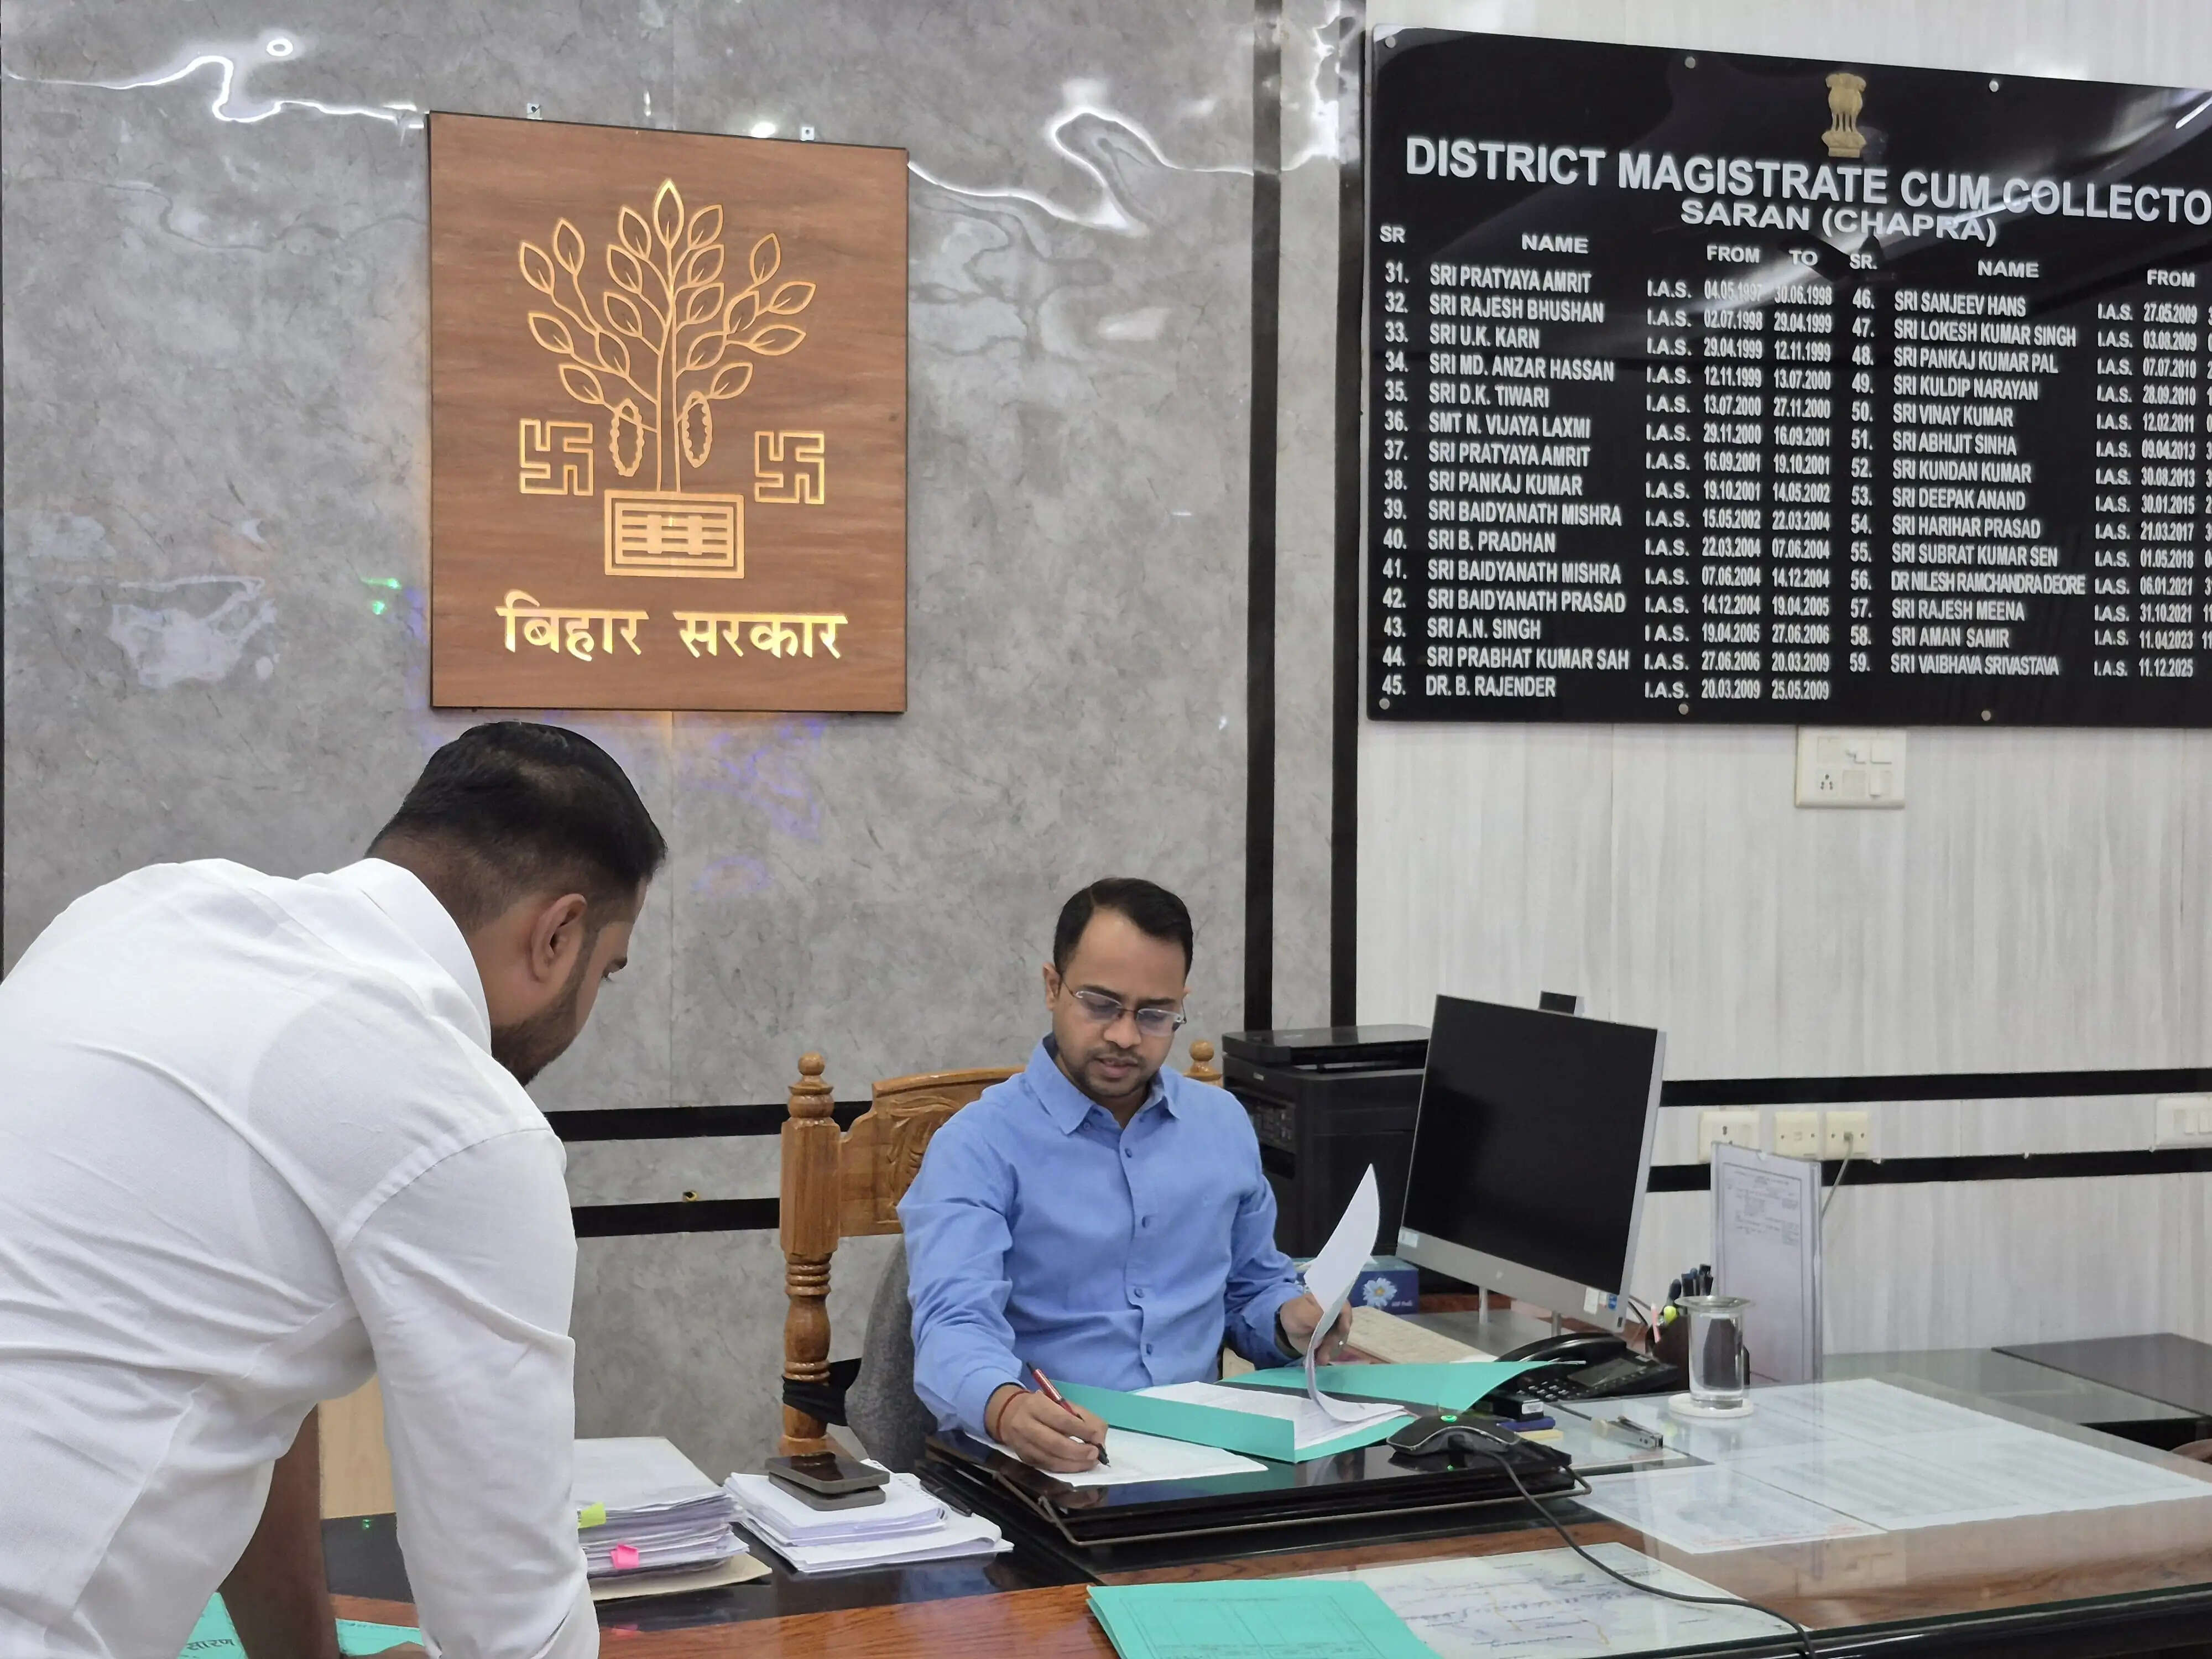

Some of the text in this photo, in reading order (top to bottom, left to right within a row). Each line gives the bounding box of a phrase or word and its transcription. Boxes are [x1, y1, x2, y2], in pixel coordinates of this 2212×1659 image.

[1406, 136, 2212, 225] DISTRICT MAGISTRATE CUM COLLECTO
[1681, 200, 1996, 247] SARAN (CHAPRA)
[1379, 225, 1818, 267] SR NAME FROM TO
[1384, 260, 1593, 294] 31. SRI PRATYAYA AMRIT
[1849, 254, 2195, 288] SR. NAME FROM
[1384, 290, 1604, 324] 32. SRI RAJESH BHUSHAN
[1851, 288, 2027, 317] 46. SRI SANJEEV HANS
[1385, 320, 1540, 349] 33. SRI U.K. KARN
[1851, 315, 2077, 348] 47. SRI LOKESH KUMAR SINGH
[1384, 349, 1692, 385] 34. SRI MD. ANZAR HASSAN I.A.S.
[1851, 344, 2197, 379] 48. SRI PANKAJ KUMAR PAL 07.07.2010
[1384, 379, 1550, 409] 35. SRI D.K. TIWARI
[1851, 372, 2038, 401] 49. SRI KULDIP NARAYAN
[1384, 409, 1830, 447] 36. SMT N. VIJAYA LAXMI 29.11.2000 16.09.2001
[1851, 399, 2014, 428] 50. SRI VINAY KUMAR
[1383, 439, 1592, 468] 37. SRI PRATYAYA AMRIT
[1850, 427, 2018, 456] 51. SRI ABHIJIT SINHA
[1384, 468, 1583, 497] 38. SRI PANKAJ KUMAR
[1850, 456, 2132, 486] 52. SRI KUNDAN KUMAR I.A.S.
[1383, 497, 1623, 527] 39. SRI BAIDYANATH MISHRA
[1850, 484, 2026, 512] 53. SRI DEEPAK ANAND
[1850, 512, 2041, 540] 54. SRI HARIHAR PRASAD
[1383, 527, 1761, 559] 40. SRI B. PRADHAN 22.03.2004
[1850, 541, 2194, 570] 55. SRI SUBRAT KUMAR SEN 01.05.2018
[1382, 557, 1690, 586] 41. SRI BAIDYANATH MISHRA I.A.S.
[1850, 568, 2086, 596] 56. DR NILESH RAMCHANDRA DEORE
[1382, 586, 1627, 613] 42. SRI BAIDYANATH PRASAD
[1850, 597, 2026, 622] 57. SRI RAJESH MEENA
[495, 589, 848, 661] बिहार सरकार
[1383, 615, 1541, 640] 43. SRI A.N. SINGH
[1850, 624, 2010, 649] 58. SRI AMAN SAMIR
[1382, 645, 1830, 673] 44. SRI PRABHAT KUMAR SAH 27.06.2006 20.03.2009
[1849, 651, 2194, 678] 59. SRI VAIBHAVA SRIVASTAVA 11.12.2025
[1381, 674, 1556, 698] 45. DR. B. RAJENDER
